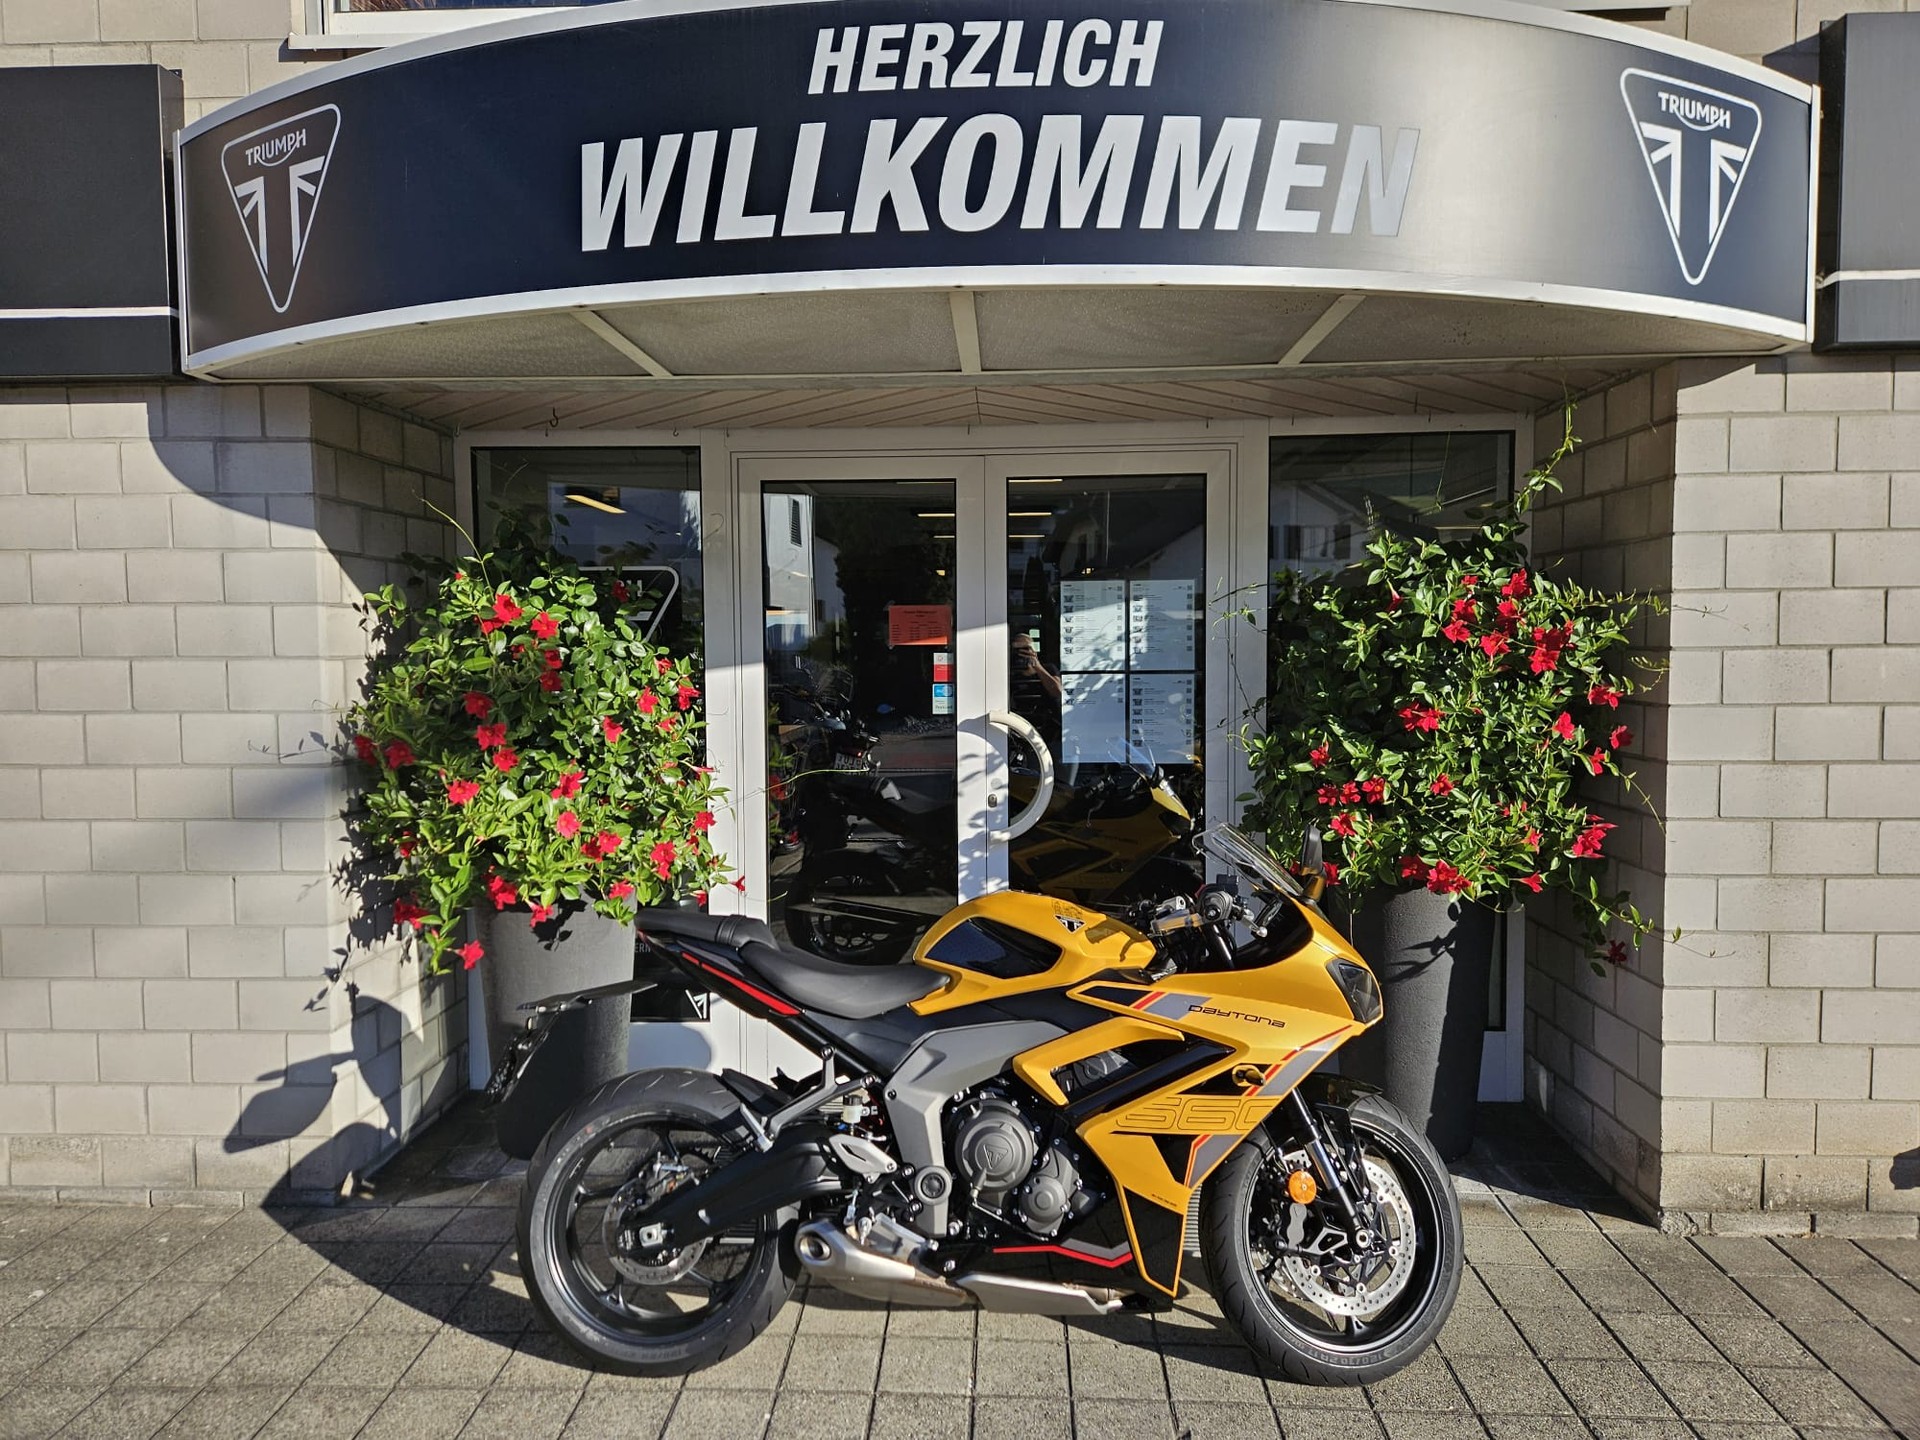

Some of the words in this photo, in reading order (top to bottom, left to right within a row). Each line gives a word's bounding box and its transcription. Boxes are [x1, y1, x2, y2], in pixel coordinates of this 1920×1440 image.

[808, 19, 1164, 95] HERZLICH
[1658, 91, 1731, 131] TRIUMPH
[245, 128, 306, 166] TRIUMPH
[581, 113, 1421, 252] WILLKOMMEN
